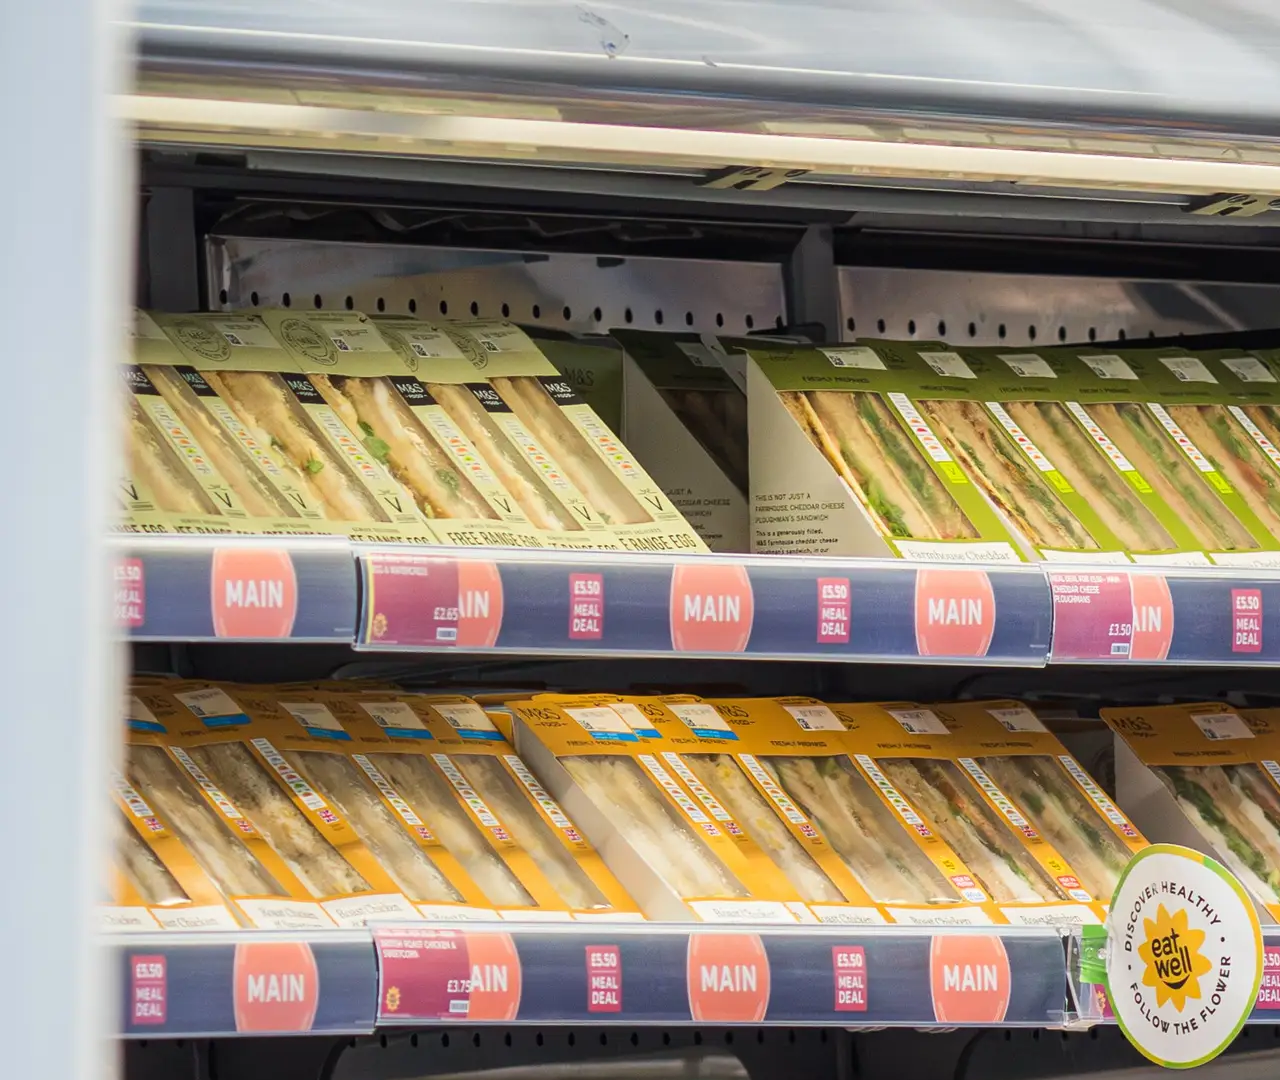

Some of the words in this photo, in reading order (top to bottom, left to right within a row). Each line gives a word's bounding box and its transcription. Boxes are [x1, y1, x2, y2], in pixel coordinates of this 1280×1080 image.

[545, 382, 572, 394] M&S
[787, 503, 819, 511] CHEDDAR
[821, 502, 845, 510] CHEESE
[796, 514, 829, 522] SANDWICH
[632, 535, 671, 550] RANGE
[673, 535, 696, 548] EGG
[909, 549, 964, 561] Farmhouse
[965, 549, 1010, 561] Cheddar
[225, 579, 283, 608] MAIN
[822, 584, 847, 599] £5.50
[684, 595, 740, 622] MAIN
[1236, 596, 1259, 609] £5.50
[822, 607, 847, 620] MEAL
[928, 598, 982, 625] MAIN
[822, 622, 846, 636] DEAL
[1108, 623, 1131, 637] £3.50
[1236, 618, 1260, 630] MEAL
[1236, 632, 1259, 645] DEAL
[518, 708, 561, 720] M&S
[1125, 883, 1158, 952] DISCOVER
[1162, 881, 1221, 925] HEALTHY
[1152, 928, 1180, 957] eat
[837, 953, 862, 967] £5.50
[1155, 946, 1192, 979] well
[700, 965, 757, 992] MAIN
[838, 976, 863, 989] MEAL
[943, 964, 998, 992] MAIN
[248, 974, 304, 1002] MAIN
[447, 980, 472, 993] £3.75
[838, 990, 863, 1004] DEAL
[1130, 983, 1170, 1033] FOLLOW
[1174, 1018, 1198, 1035] THE
[1201, 956, 1231, 1022] FLOWER
